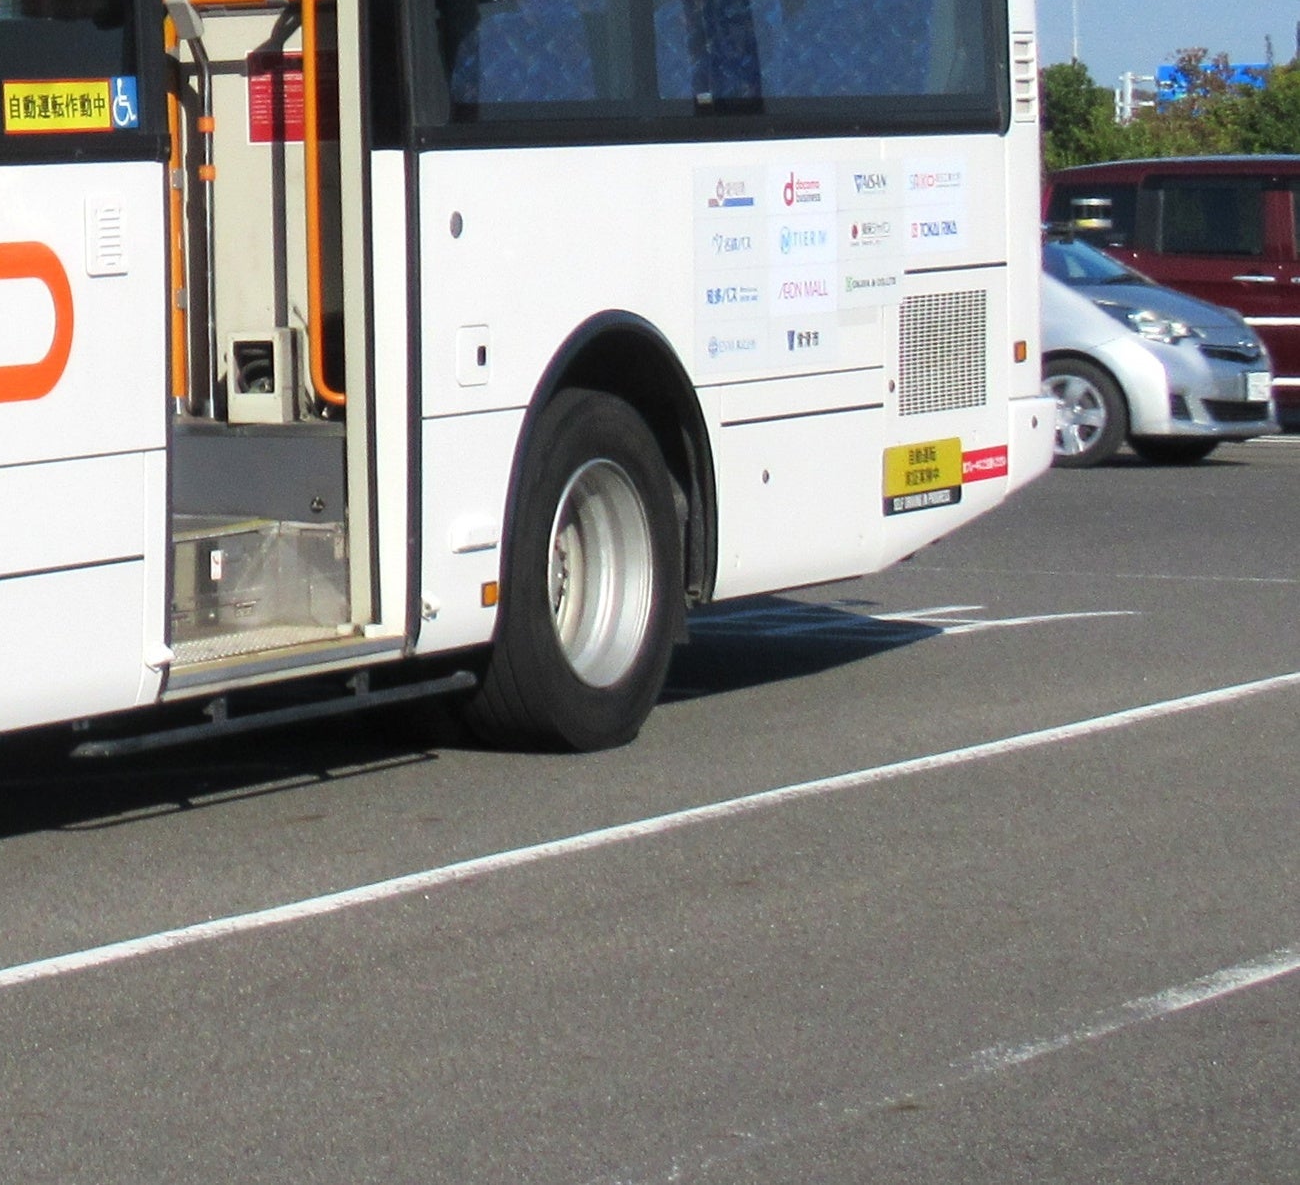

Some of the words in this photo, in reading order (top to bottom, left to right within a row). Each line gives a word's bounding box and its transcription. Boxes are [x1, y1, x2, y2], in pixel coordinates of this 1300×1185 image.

[8, 92, 106, 120] 自動運転作動中
